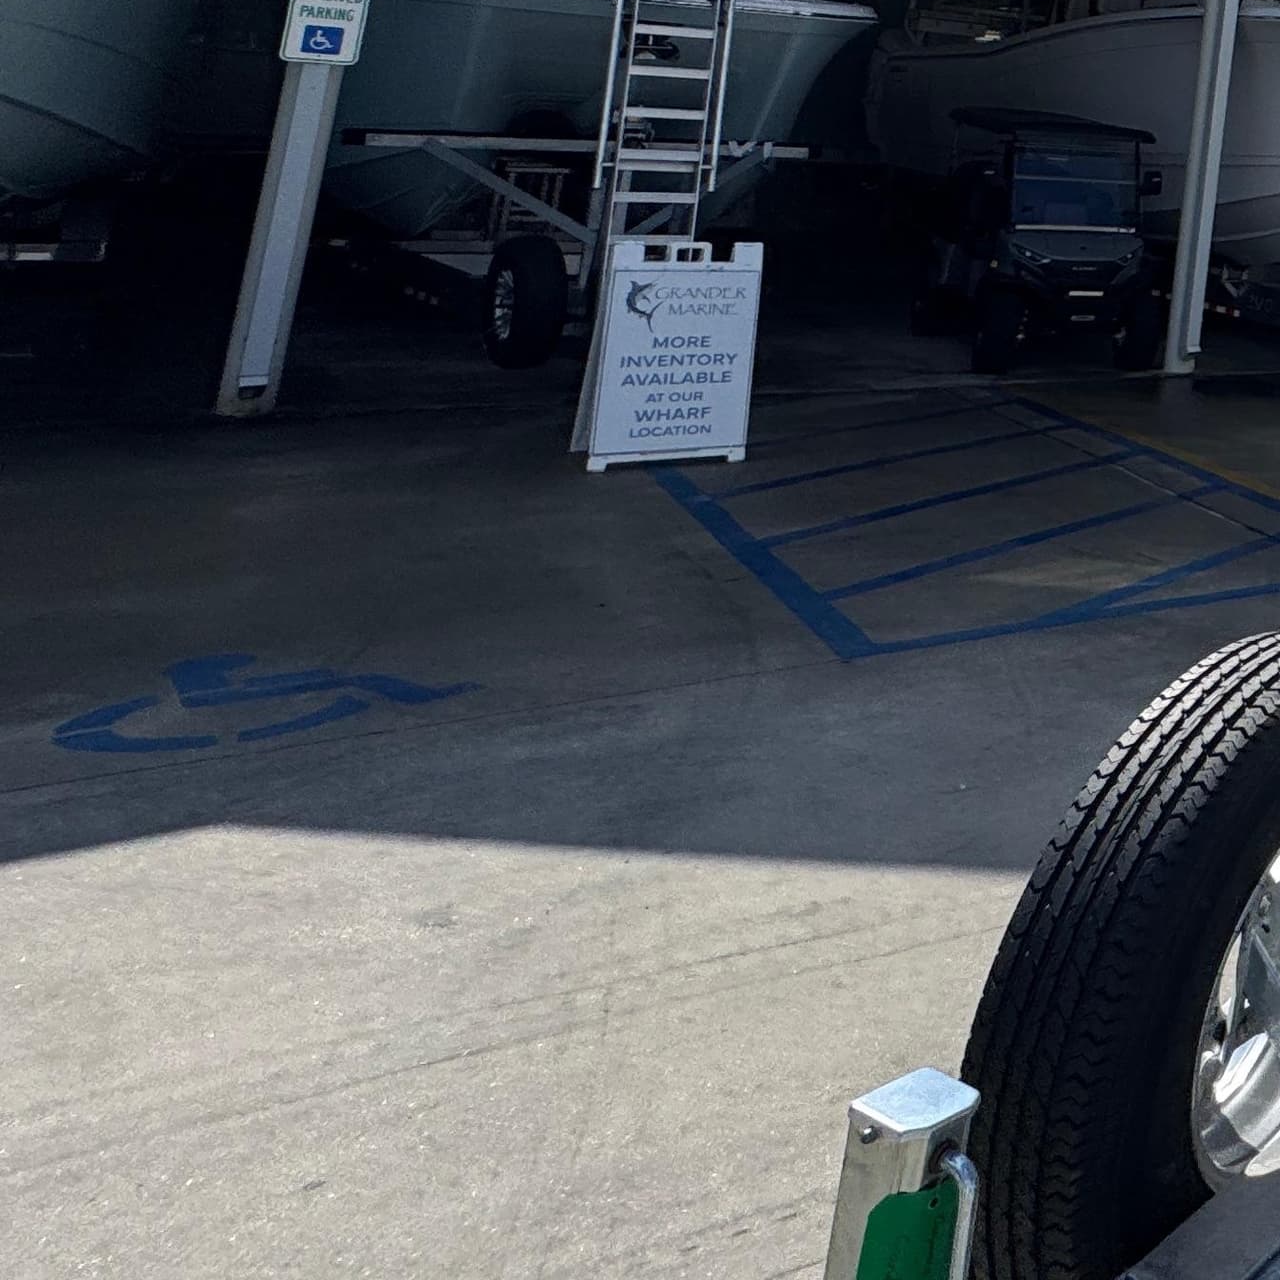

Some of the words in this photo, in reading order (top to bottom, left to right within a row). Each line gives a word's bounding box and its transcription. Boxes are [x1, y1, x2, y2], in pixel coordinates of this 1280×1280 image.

[300, 5, 356, 22] PARKING
[655, 286, 747, 300] GRANDER
[668, 303, 738, 316] MARINE
[651, 336, 712, 349] MORE
[620, 353, 738, 368] INVENTORY
[621, 371, 733, 387] AVAILABLE
[644, 393, 665, 403] AT
[668, 391, 704, 402] OUR
[633, 406, 712, 423] WHARF
[628, 424, 712, 439] LOCATION
